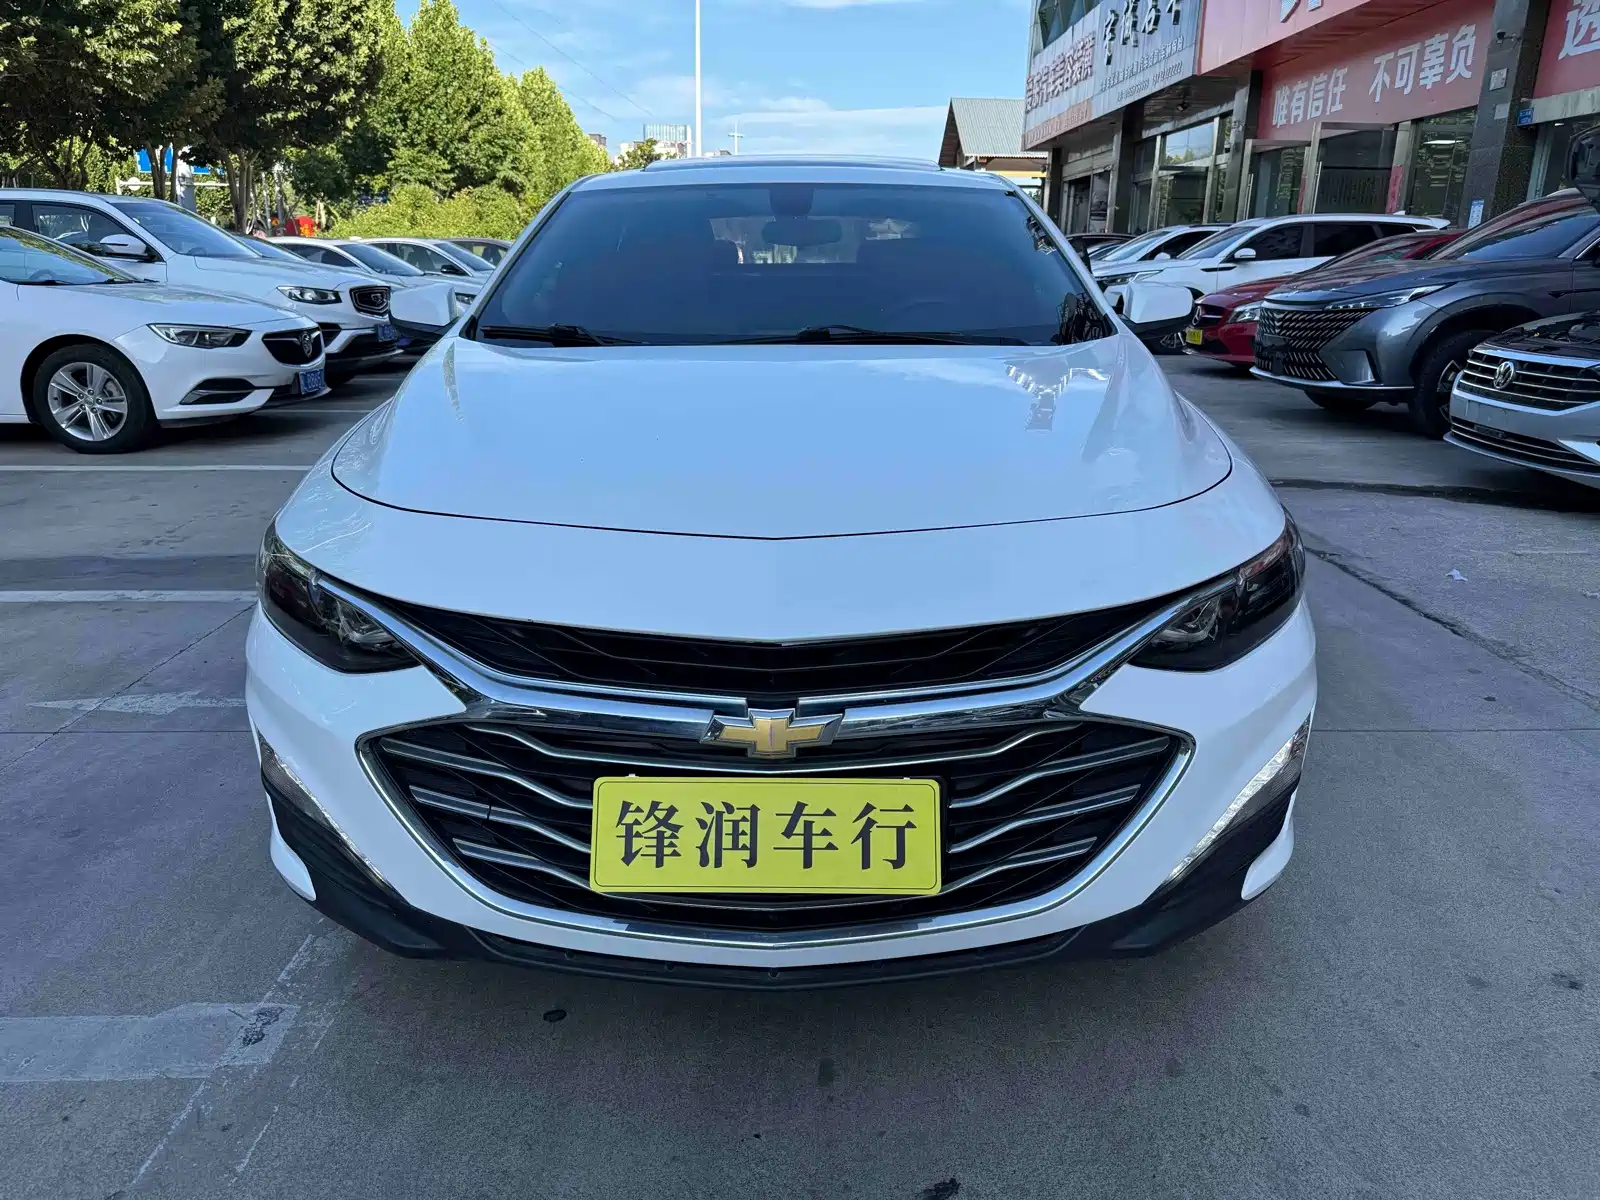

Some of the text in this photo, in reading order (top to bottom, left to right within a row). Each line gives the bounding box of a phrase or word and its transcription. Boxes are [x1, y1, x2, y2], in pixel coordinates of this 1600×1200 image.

[1272, 24, 1476, 129] 唯有信任 不可辜负
[614, 799, 918, 870] 锋润车行
